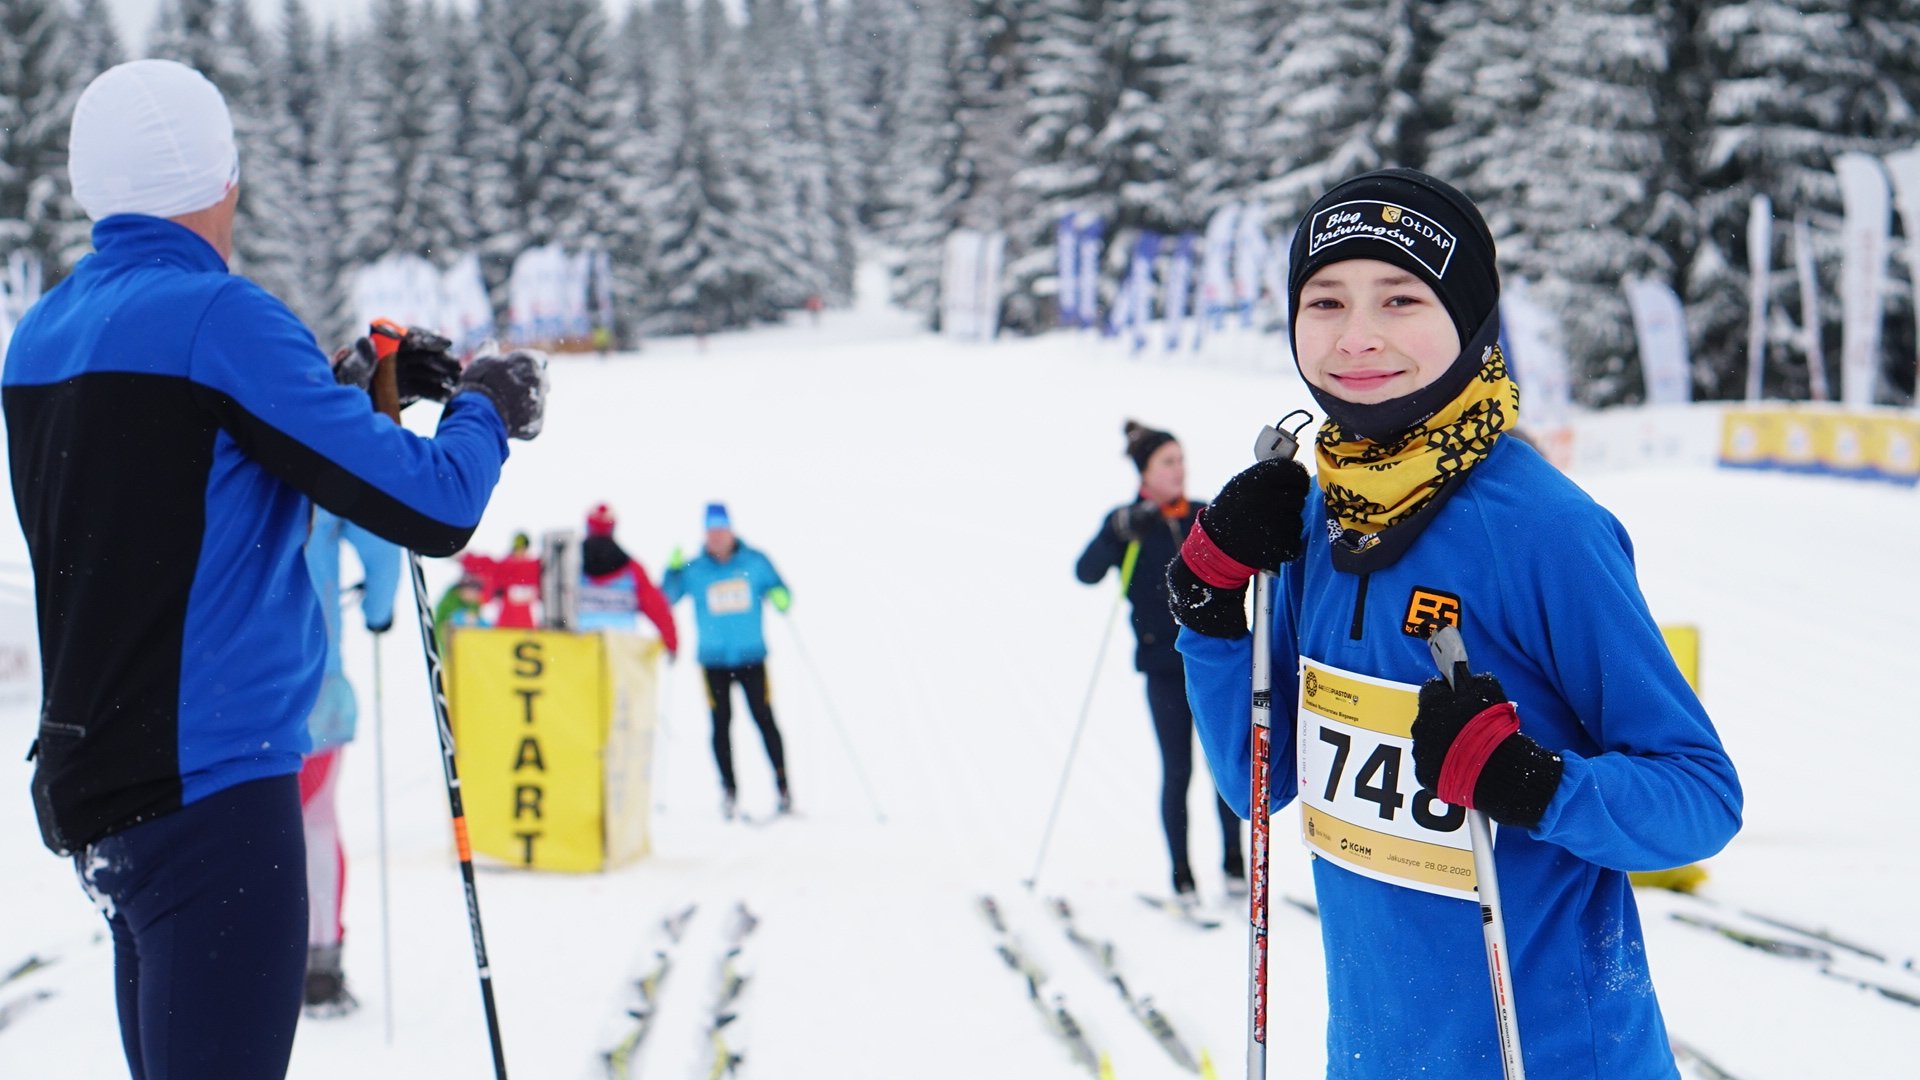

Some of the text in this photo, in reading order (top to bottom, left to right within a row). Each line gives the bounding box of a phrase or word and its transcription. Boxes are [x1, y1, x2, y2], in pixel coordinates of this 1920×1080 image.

[1325, 210, 1361, 229] Bieg
[1313, 221, 1415, 248] Jaćwingów
[513, 641, 544, 866] START
[1319, 726, 1466, 832] 748
[1349, 842, 1372, 856] KGHM
[1386, 853, 1421, 867] Jakuszyce
[1424, 861, 1472, 877] 28.02.2020
